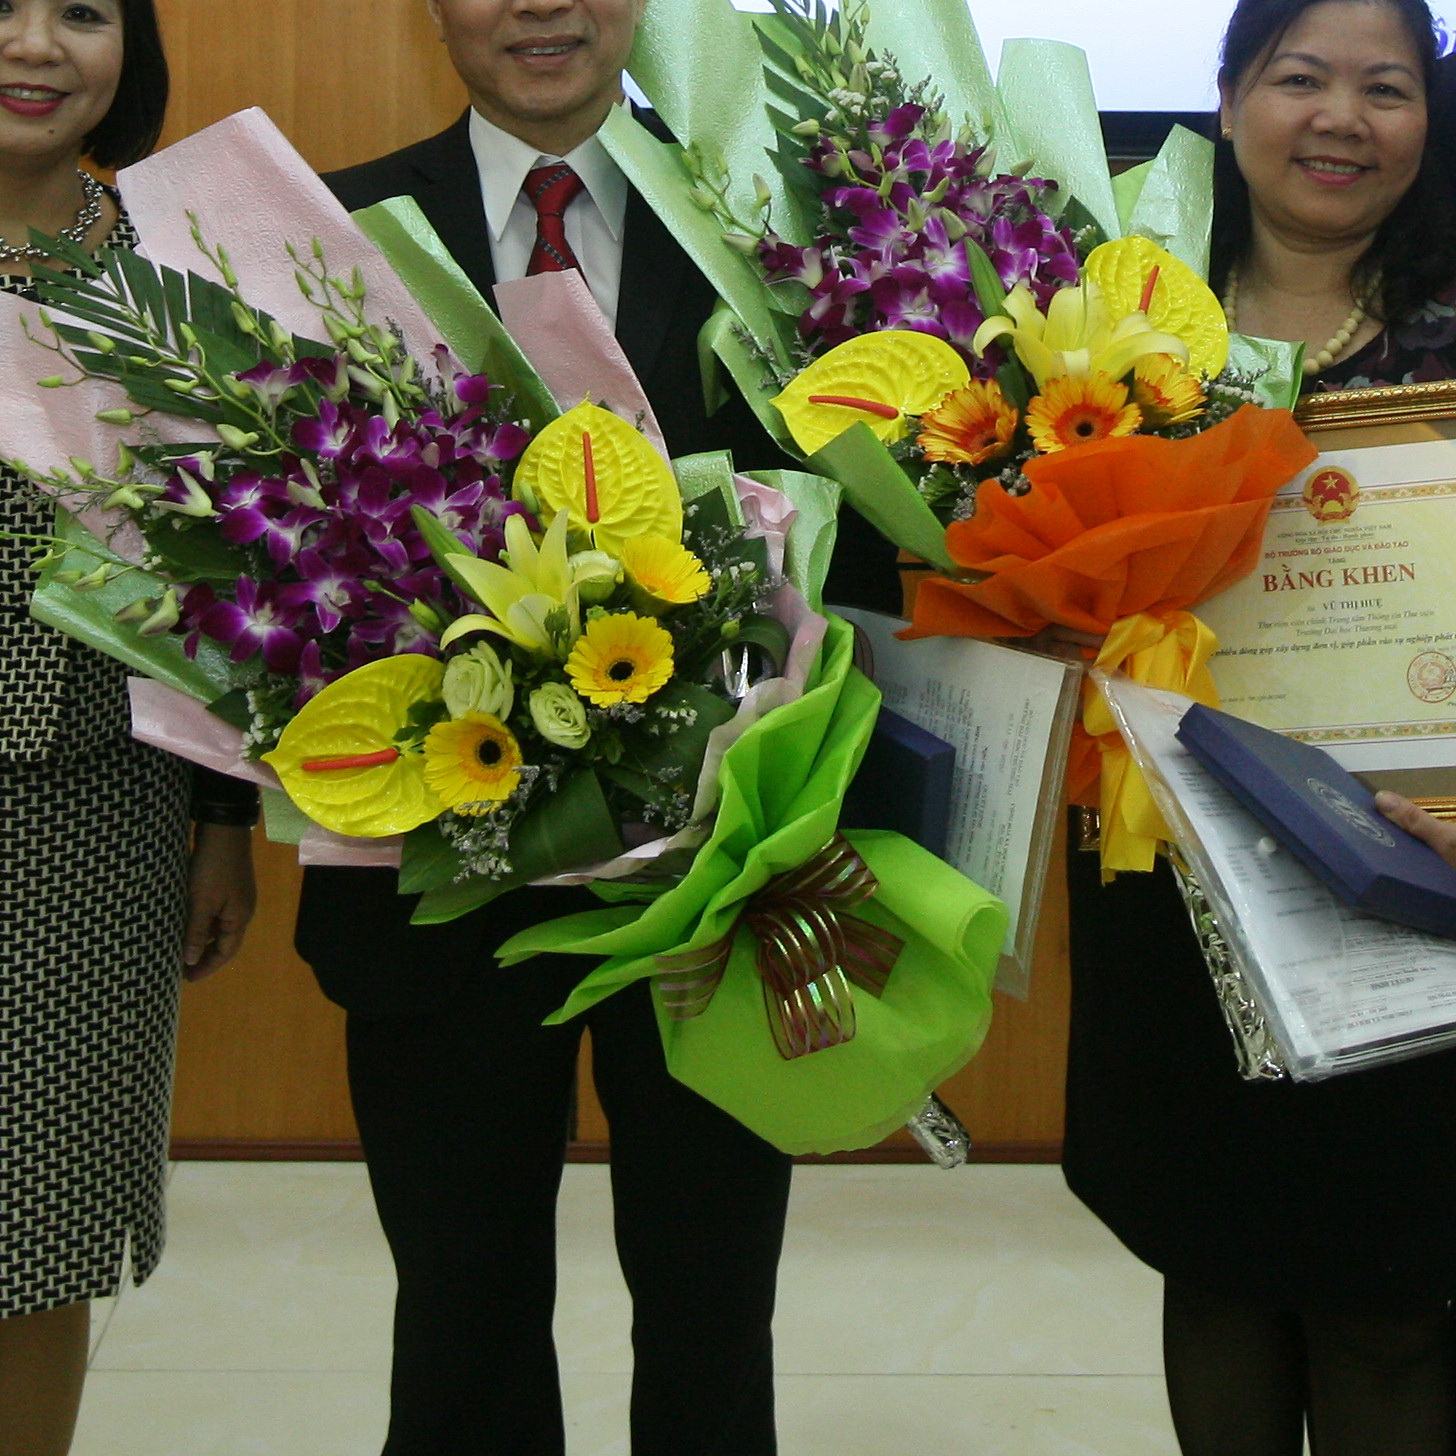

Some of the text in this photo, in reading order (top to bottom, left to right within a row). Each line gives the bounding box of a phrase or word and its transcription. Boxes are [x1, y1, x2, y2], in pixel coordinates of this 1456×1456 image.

[1262, 562, 1417, 593] BẰNG KHEN
[1340, 599, 1359, 611] THỊ
